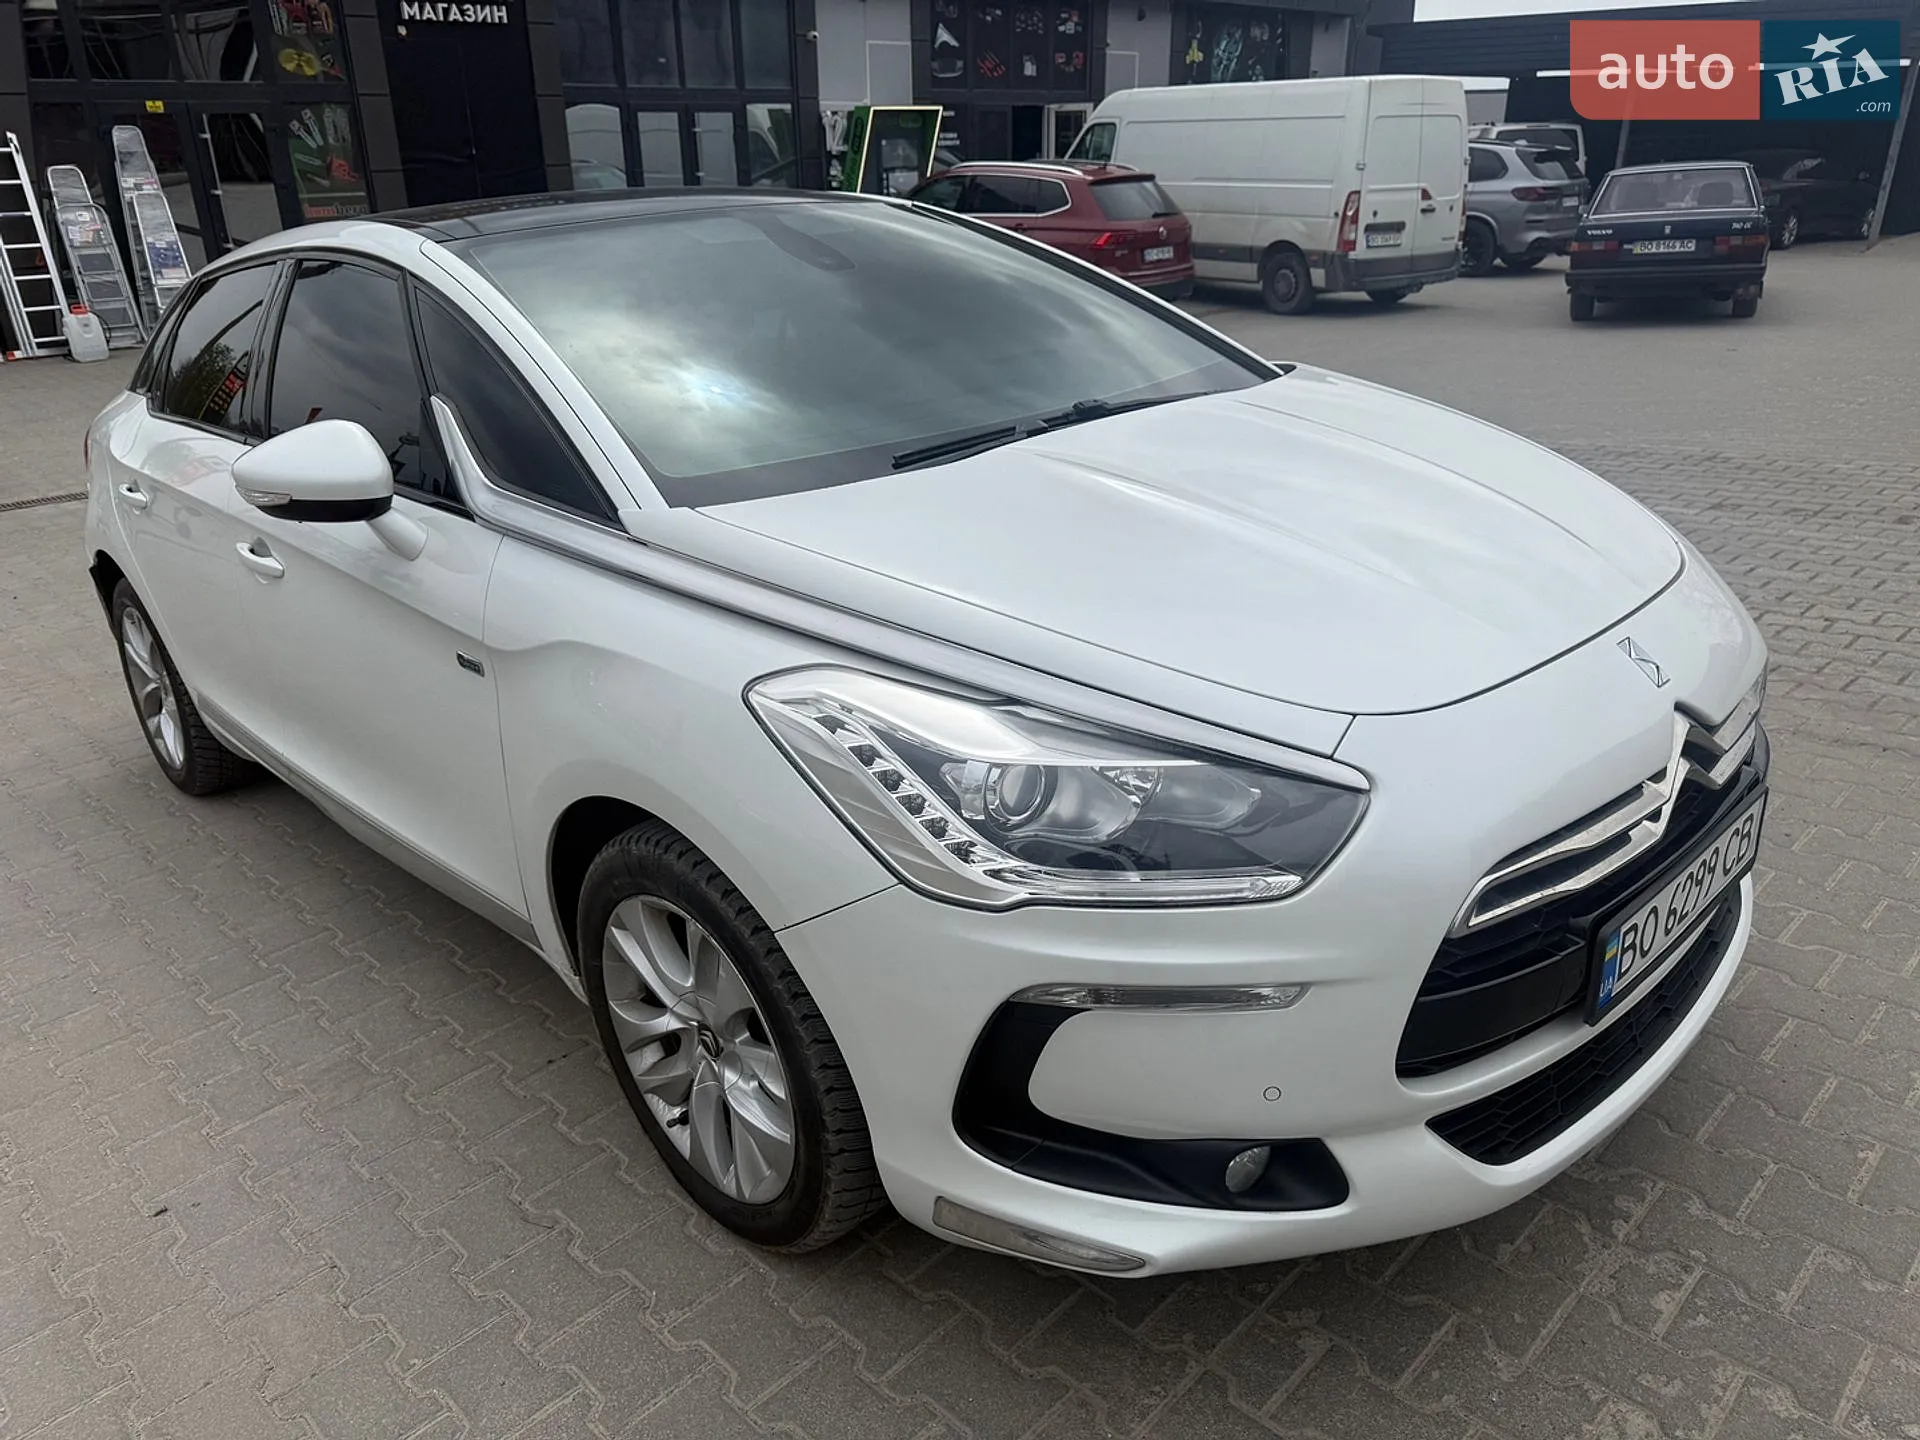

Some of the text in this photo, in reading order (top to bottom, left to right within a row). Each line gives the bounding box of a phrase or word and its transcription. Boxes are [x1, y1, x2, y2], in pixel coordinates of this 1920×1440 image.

[400, 0, 508, 24] МАГАЗИН
[1639, 240, 1653, 252] BO
[1679, 239, 1694, 250] AC
[1618, 813, 1755, 976] BO 6299 CB
[1600, 975, 1613, 997] UA
